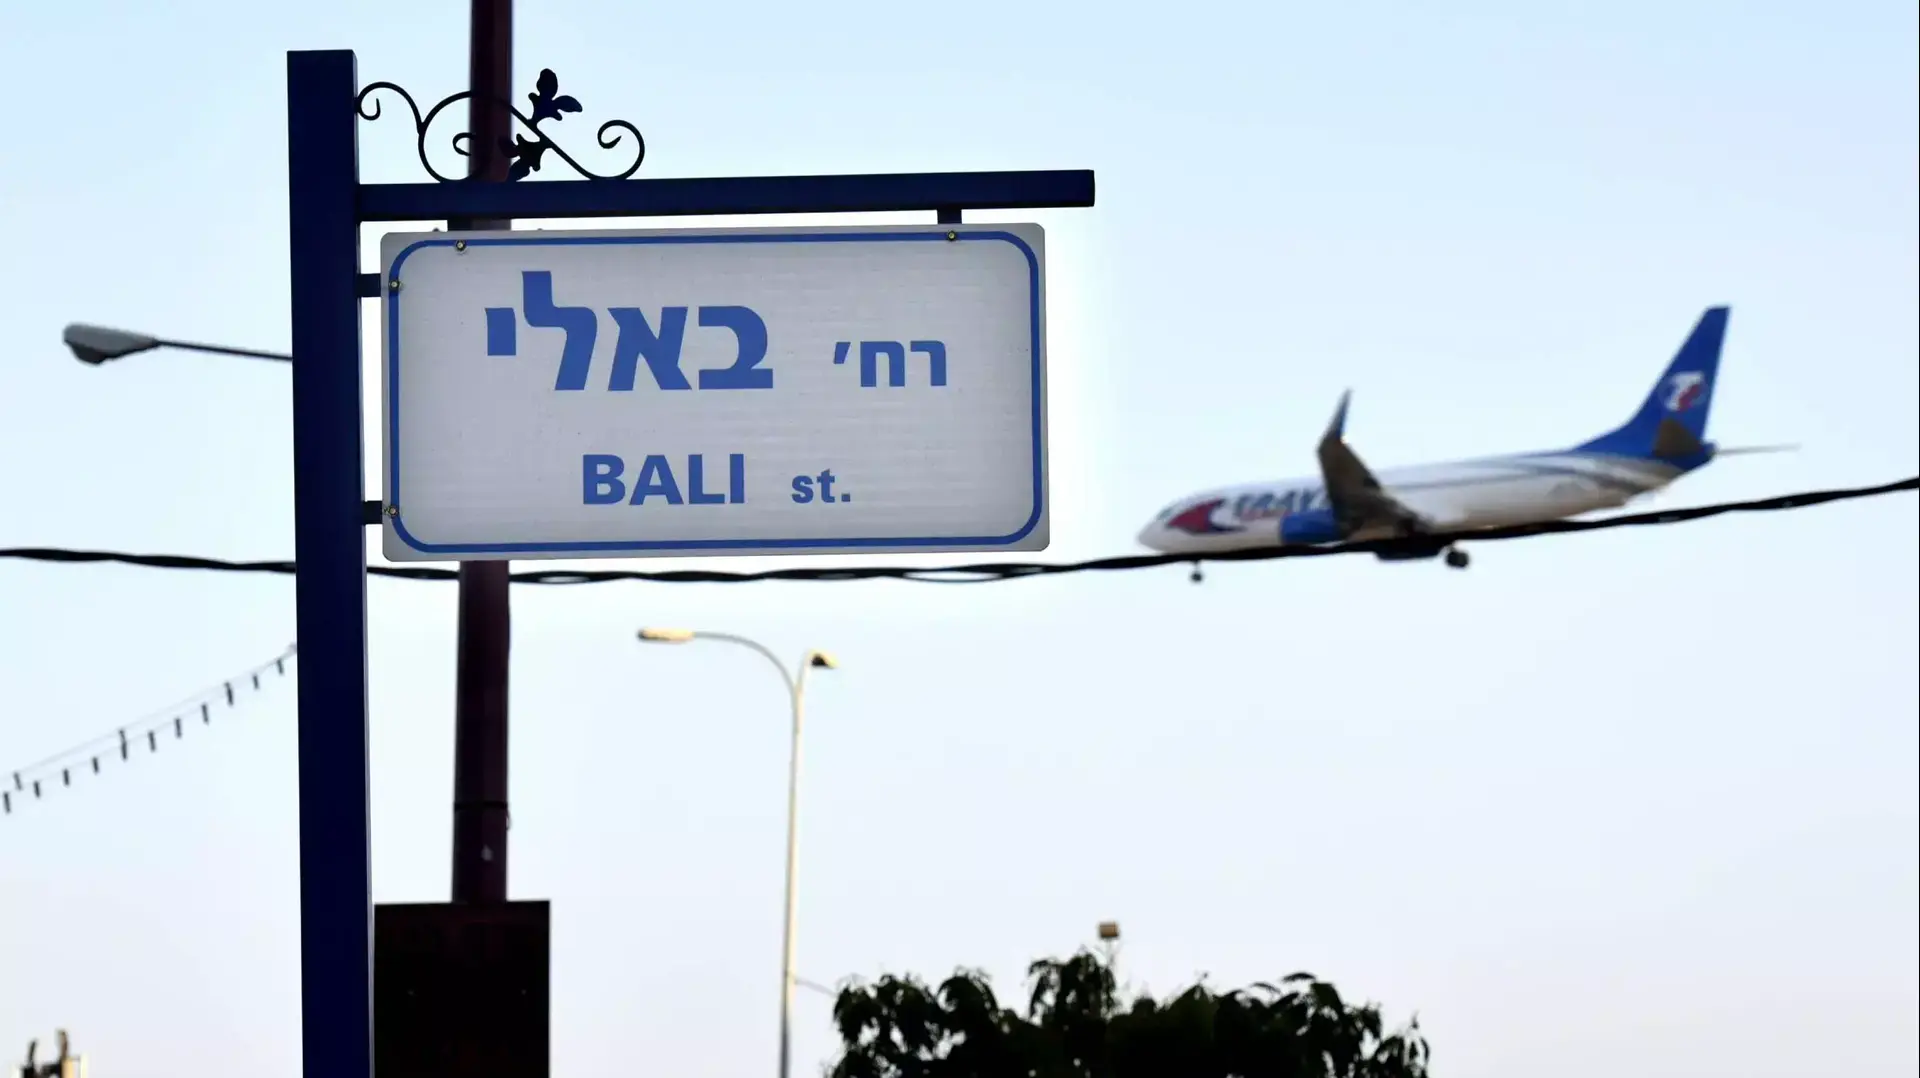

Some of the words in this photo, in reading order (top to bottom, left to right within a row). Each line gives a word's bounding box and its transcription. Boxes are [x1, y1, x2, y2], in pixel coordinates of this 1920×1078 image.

[485, 270, 774, 391] באלי
[582, 453, 745, 506] BALI
[791, 469, 851, 504] st.
